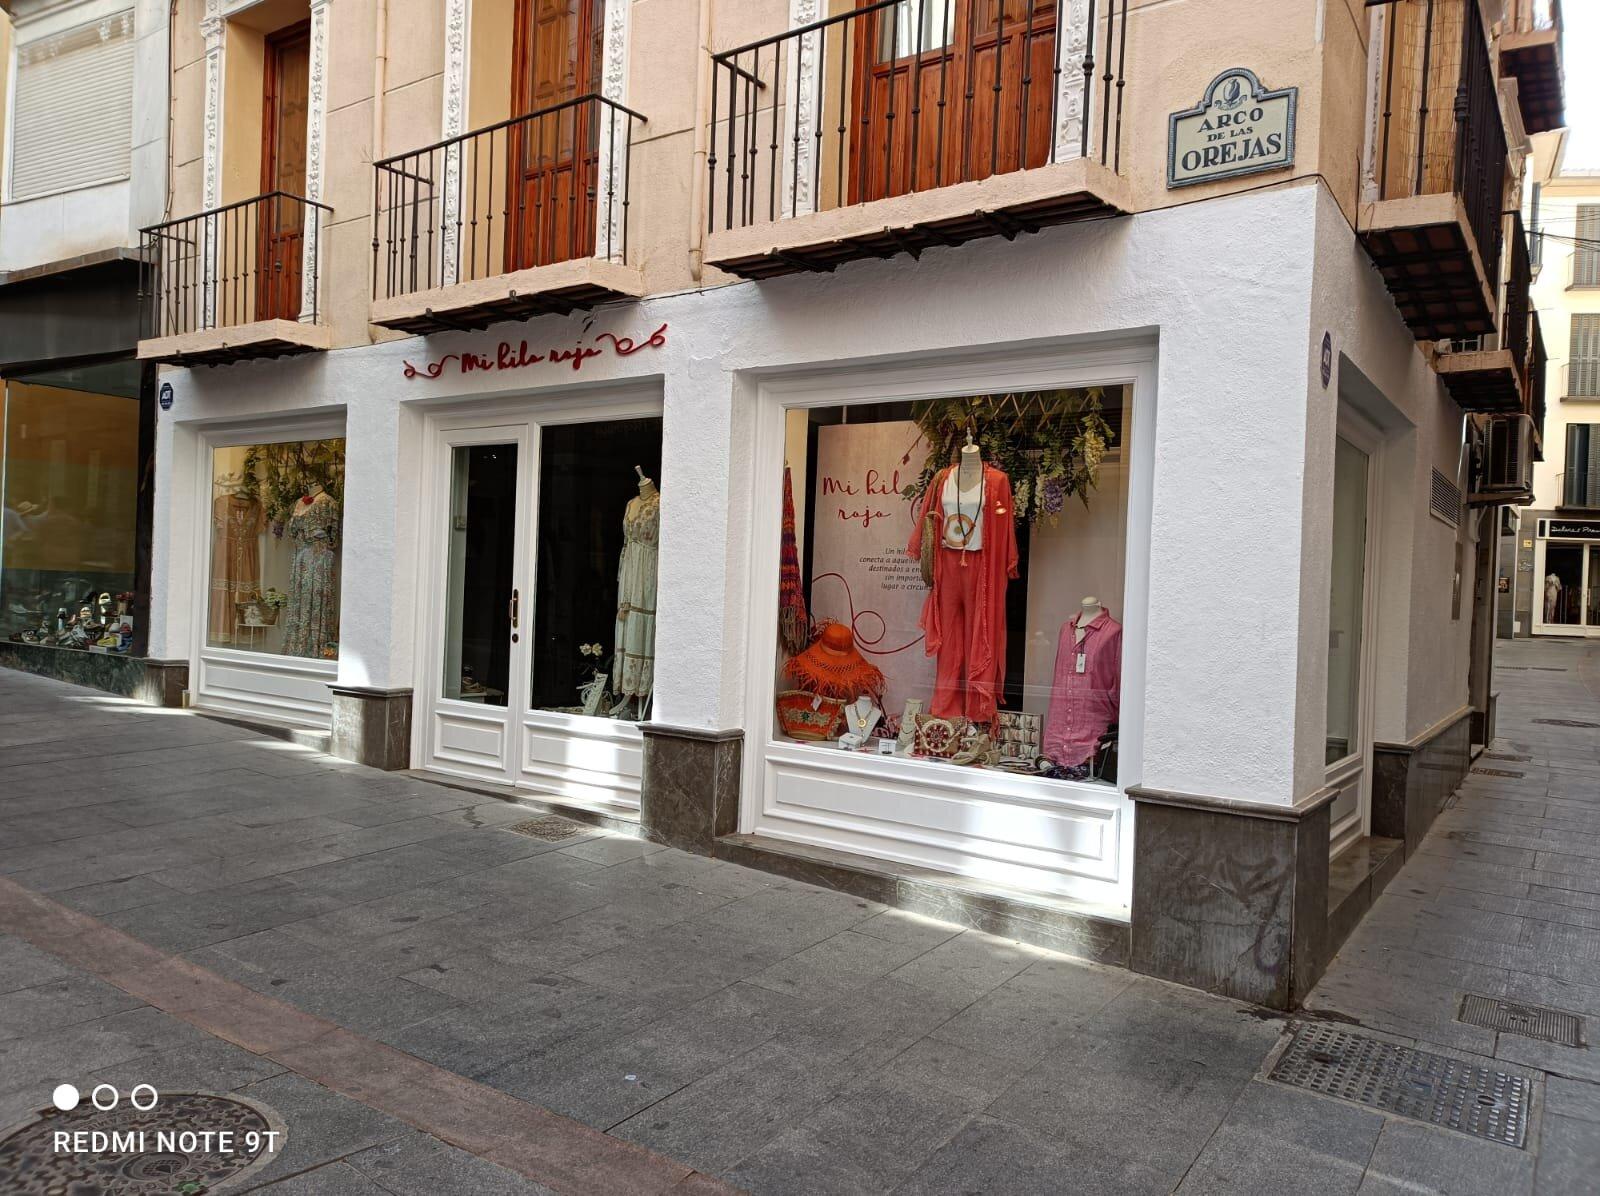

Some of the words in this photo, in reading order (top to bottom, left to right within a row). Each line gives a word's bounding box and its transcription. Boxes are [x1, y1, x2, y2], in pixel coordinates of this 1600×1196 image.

[1197, 107, 1264, 133] ARCO
[1207, 131, 1225, 142] DE
[1230, 126, 1254, 137] LAS
[1181, 132, 1282, 171] OREJAS
[461, 352, 494, 373] Mi
[498, 340, 544, 369] hilo
[549, 341, 602, 370] rojo
[823, 476, 860, 496] Mi
[866, 469, 905, 495] hil
[838, 505, 892, 528] rojo
[859, 556, 884, 564] conecta
[868, 564, 904, 574] destinados
